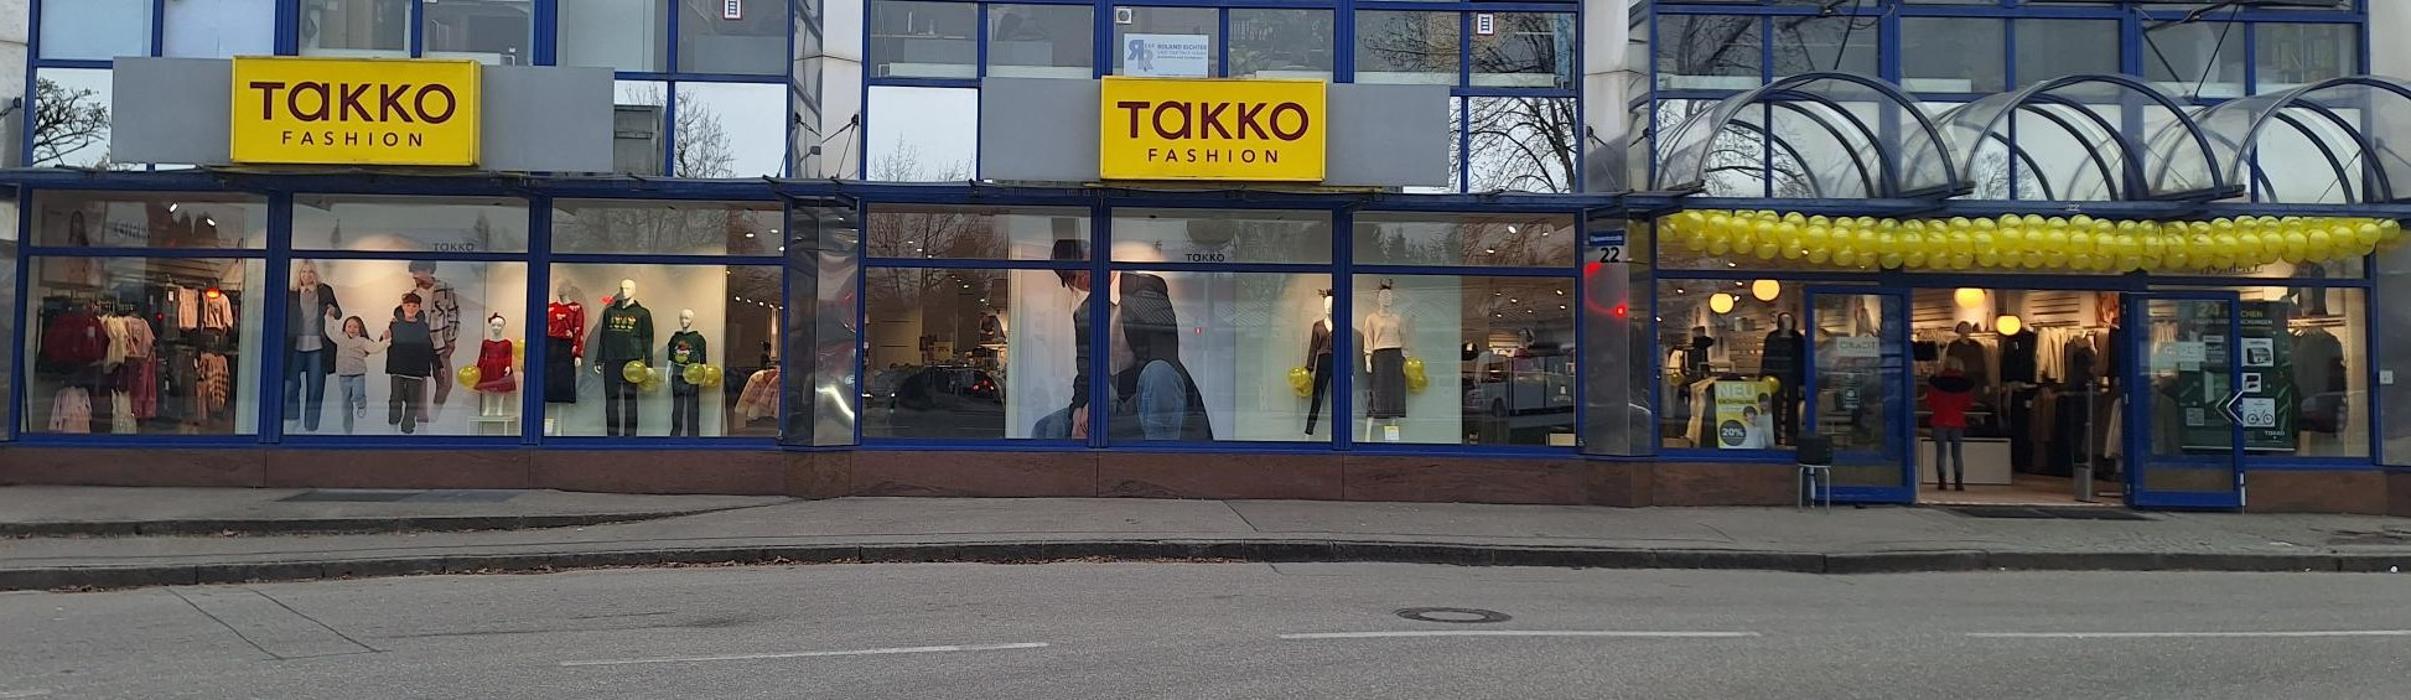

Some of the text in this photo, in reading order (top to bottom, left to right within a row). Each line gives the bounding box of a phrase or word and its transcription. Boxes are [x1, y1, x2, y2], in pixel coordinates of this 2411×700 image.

[282, 131, 422, 147] FASHION
[1148, 148, 1278, 163] FASHION
[1600, 247, 1620, 263] 22
[1715, 382, 1756, 398] NEU
[1721, 427, 1745, 438] 20%
